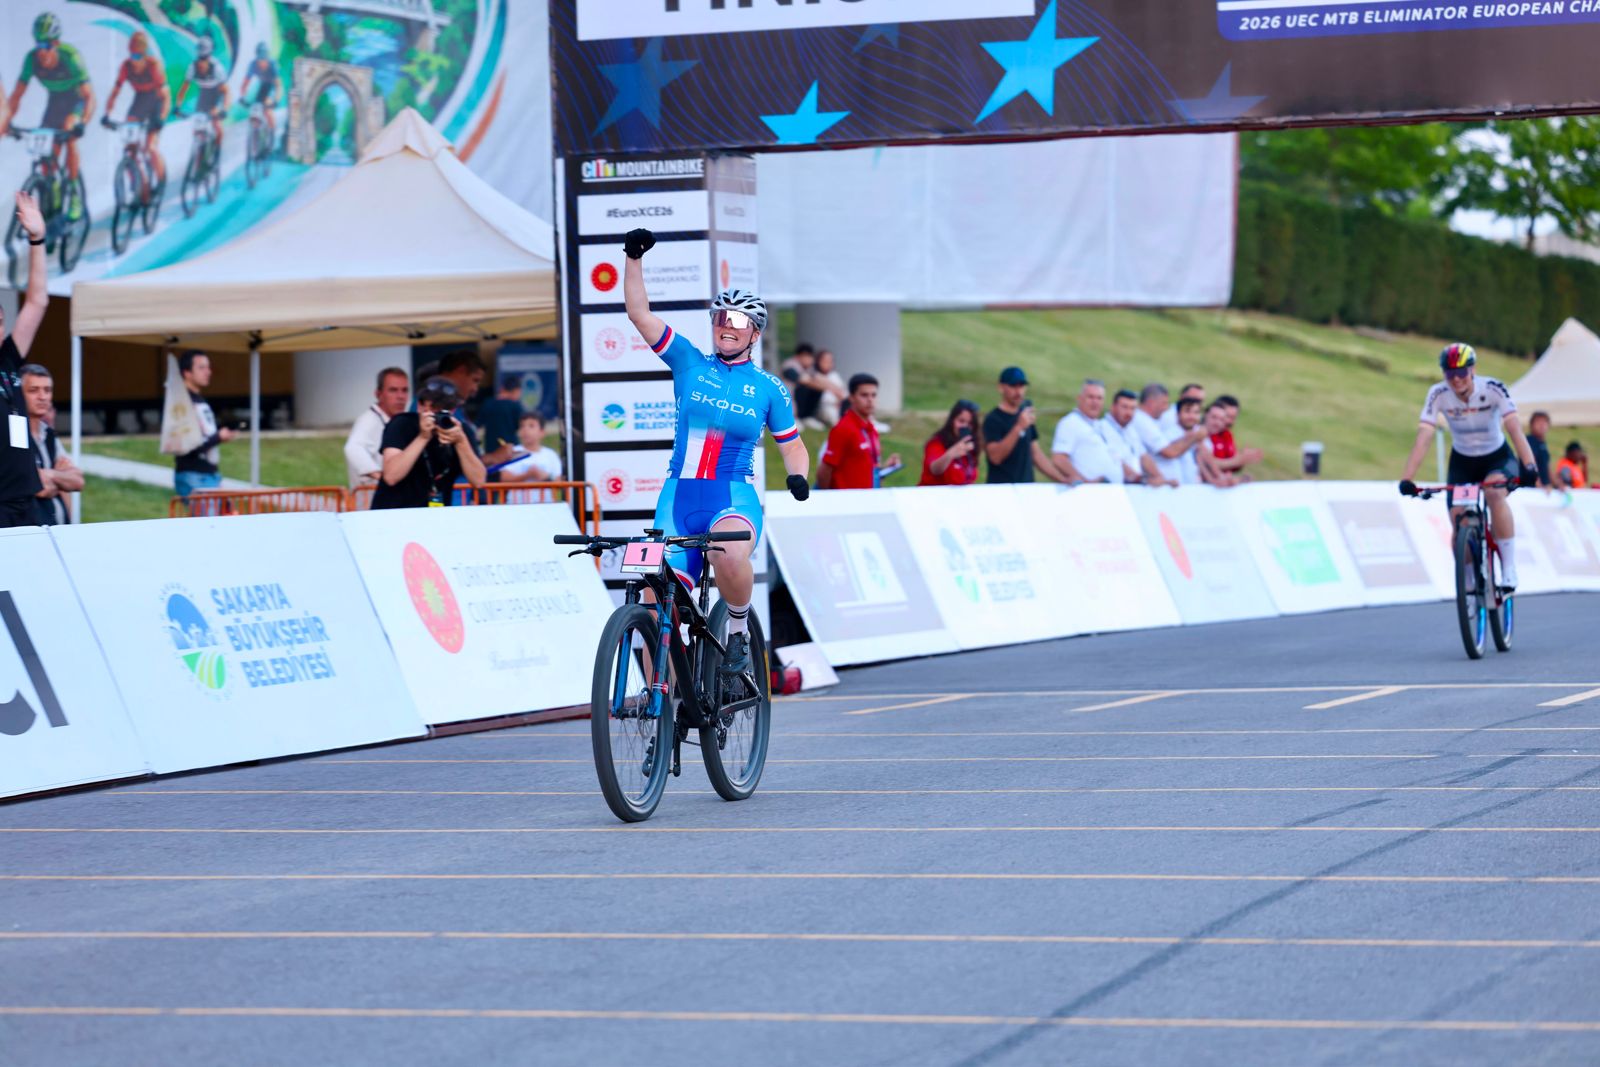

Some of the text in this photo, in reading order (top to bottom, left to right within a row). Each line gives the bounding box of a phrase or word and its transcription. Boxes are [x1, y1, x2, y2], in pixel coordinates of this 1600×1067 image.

[1239, 16, 1281, 30] 2026
[1286, 14, 1318, 28] UEC
[1323, 11, 1358, 26] MTB
[1364, 6, 1467, 24] ELIMINATOR
[1473, 2, 1564, 18] EUROPEAN
[617, 159, 704, 177] MOUNTAINBIKE
[606, 206, 674, 218] #EuroXCE26
[640, 547, 648, 561] 1
[210, 583, 292, 616] SAKARYA
[224, 610, 331, 656] BÜYÜKŞEHİR
[240, 645, 337, 688] BELEDİYESİ
